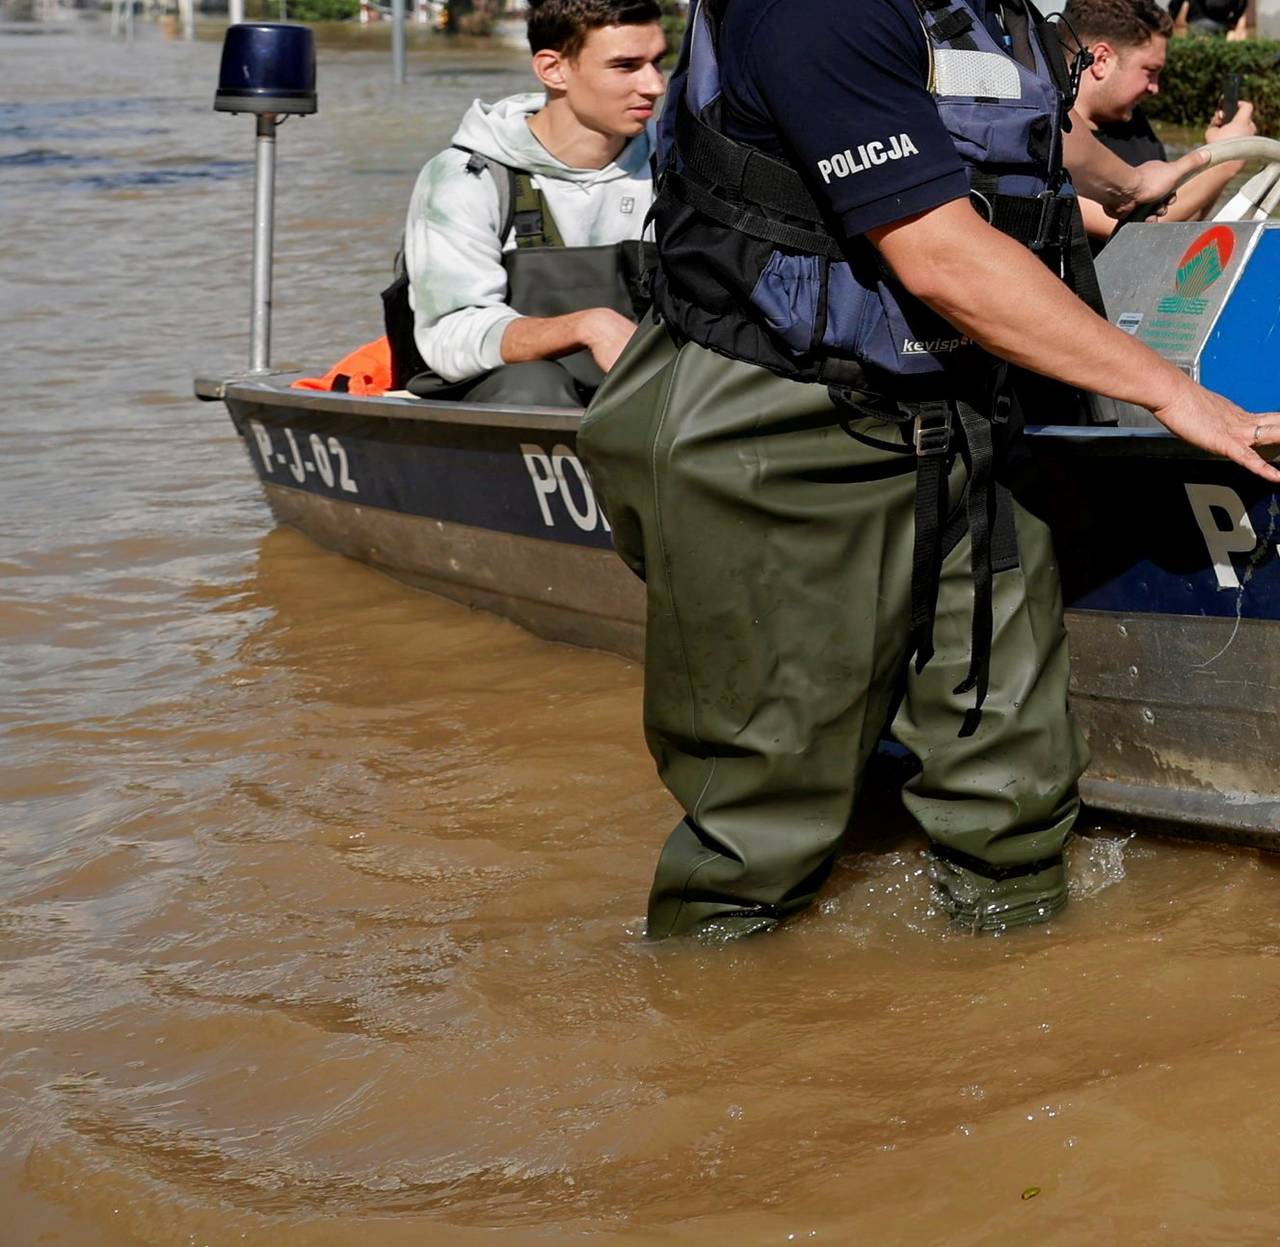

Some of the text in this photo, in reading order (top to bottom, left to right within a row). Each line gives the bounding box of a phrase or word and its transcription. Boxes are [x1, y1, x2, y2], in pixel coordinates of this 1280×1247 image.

[818, 134, 919, 184] POLICJA
[251, 419, 359, 493] P-J-02
[520, 443, 612, 533] PO
